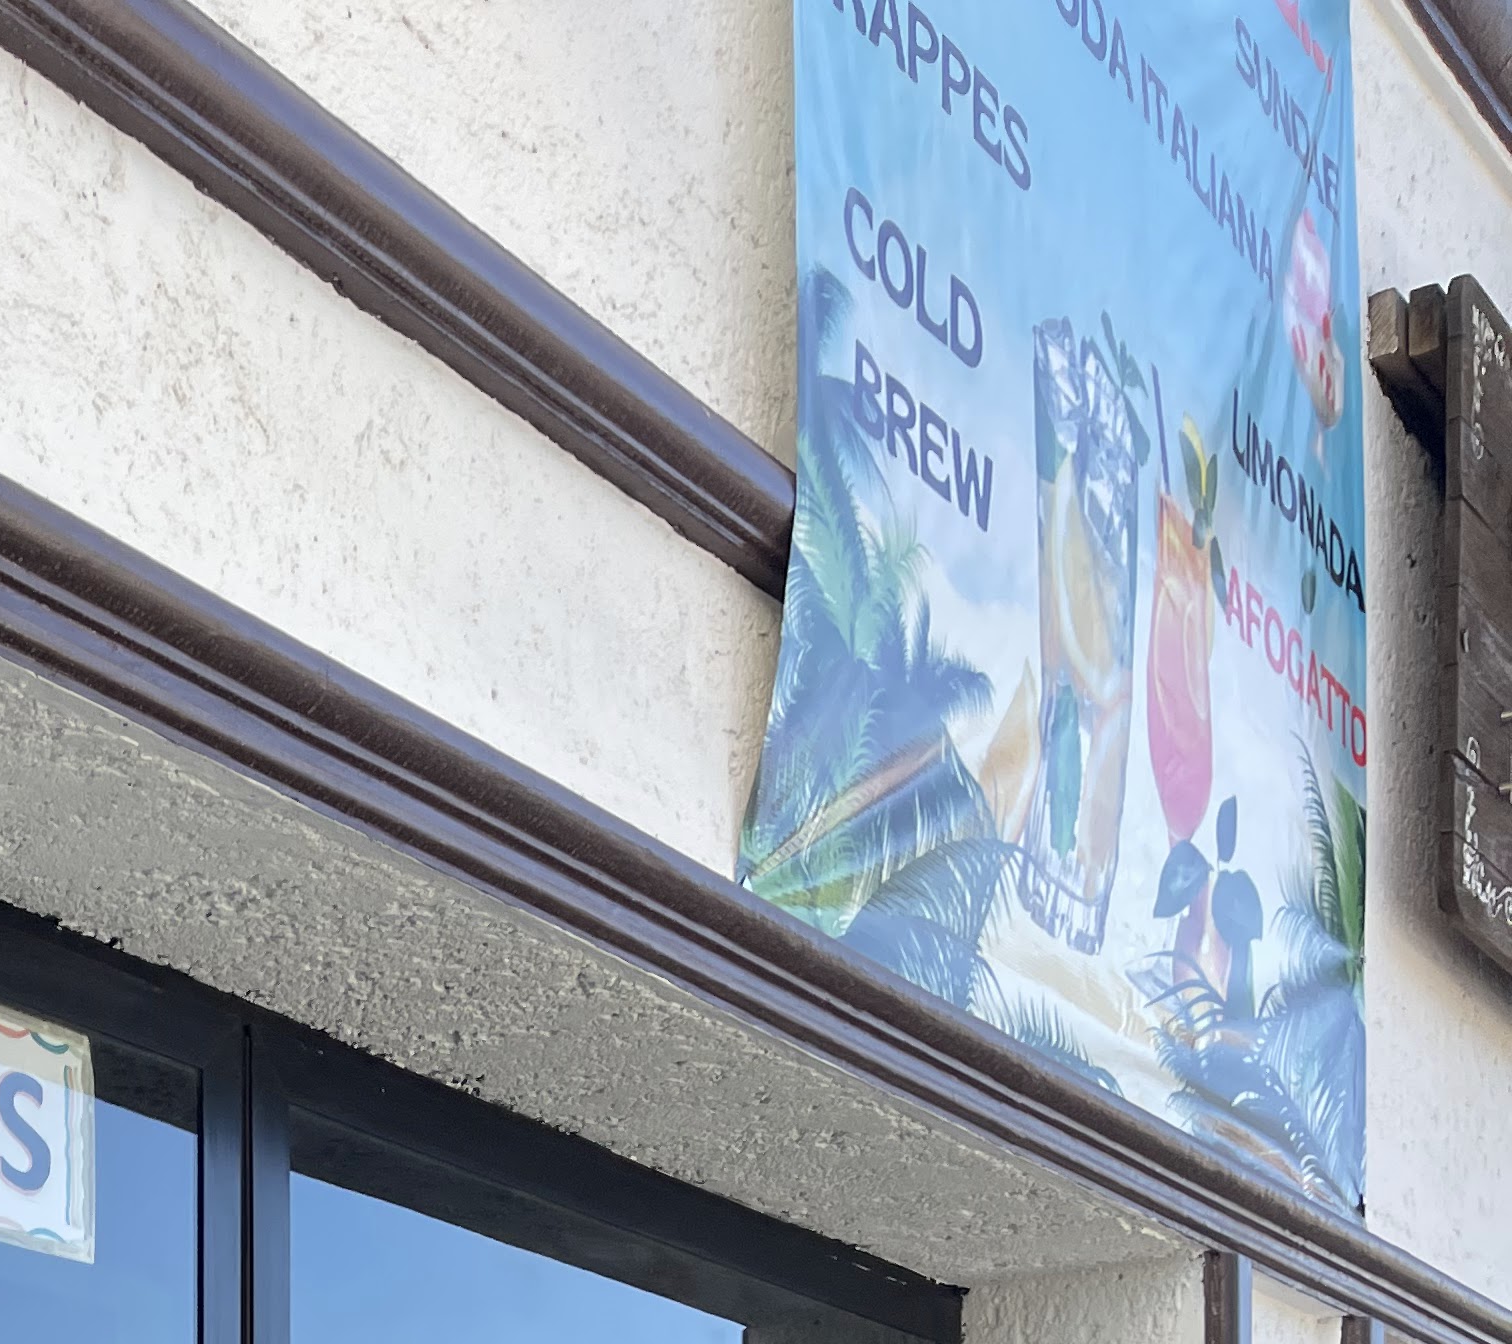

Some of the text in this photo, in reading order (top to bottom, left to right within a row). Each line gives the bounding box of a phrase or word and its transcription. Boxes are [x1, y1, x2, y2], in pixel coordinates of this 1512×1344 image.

[843, 187, 983, 368] COLD
[1140, 53, 1274, 303] ITALIANA
[852, 340, 993, 533] BREW
[1232, 386, 1365, 613] LIMONADA
[1225, 565, 1367, 769] AFOGATTO
